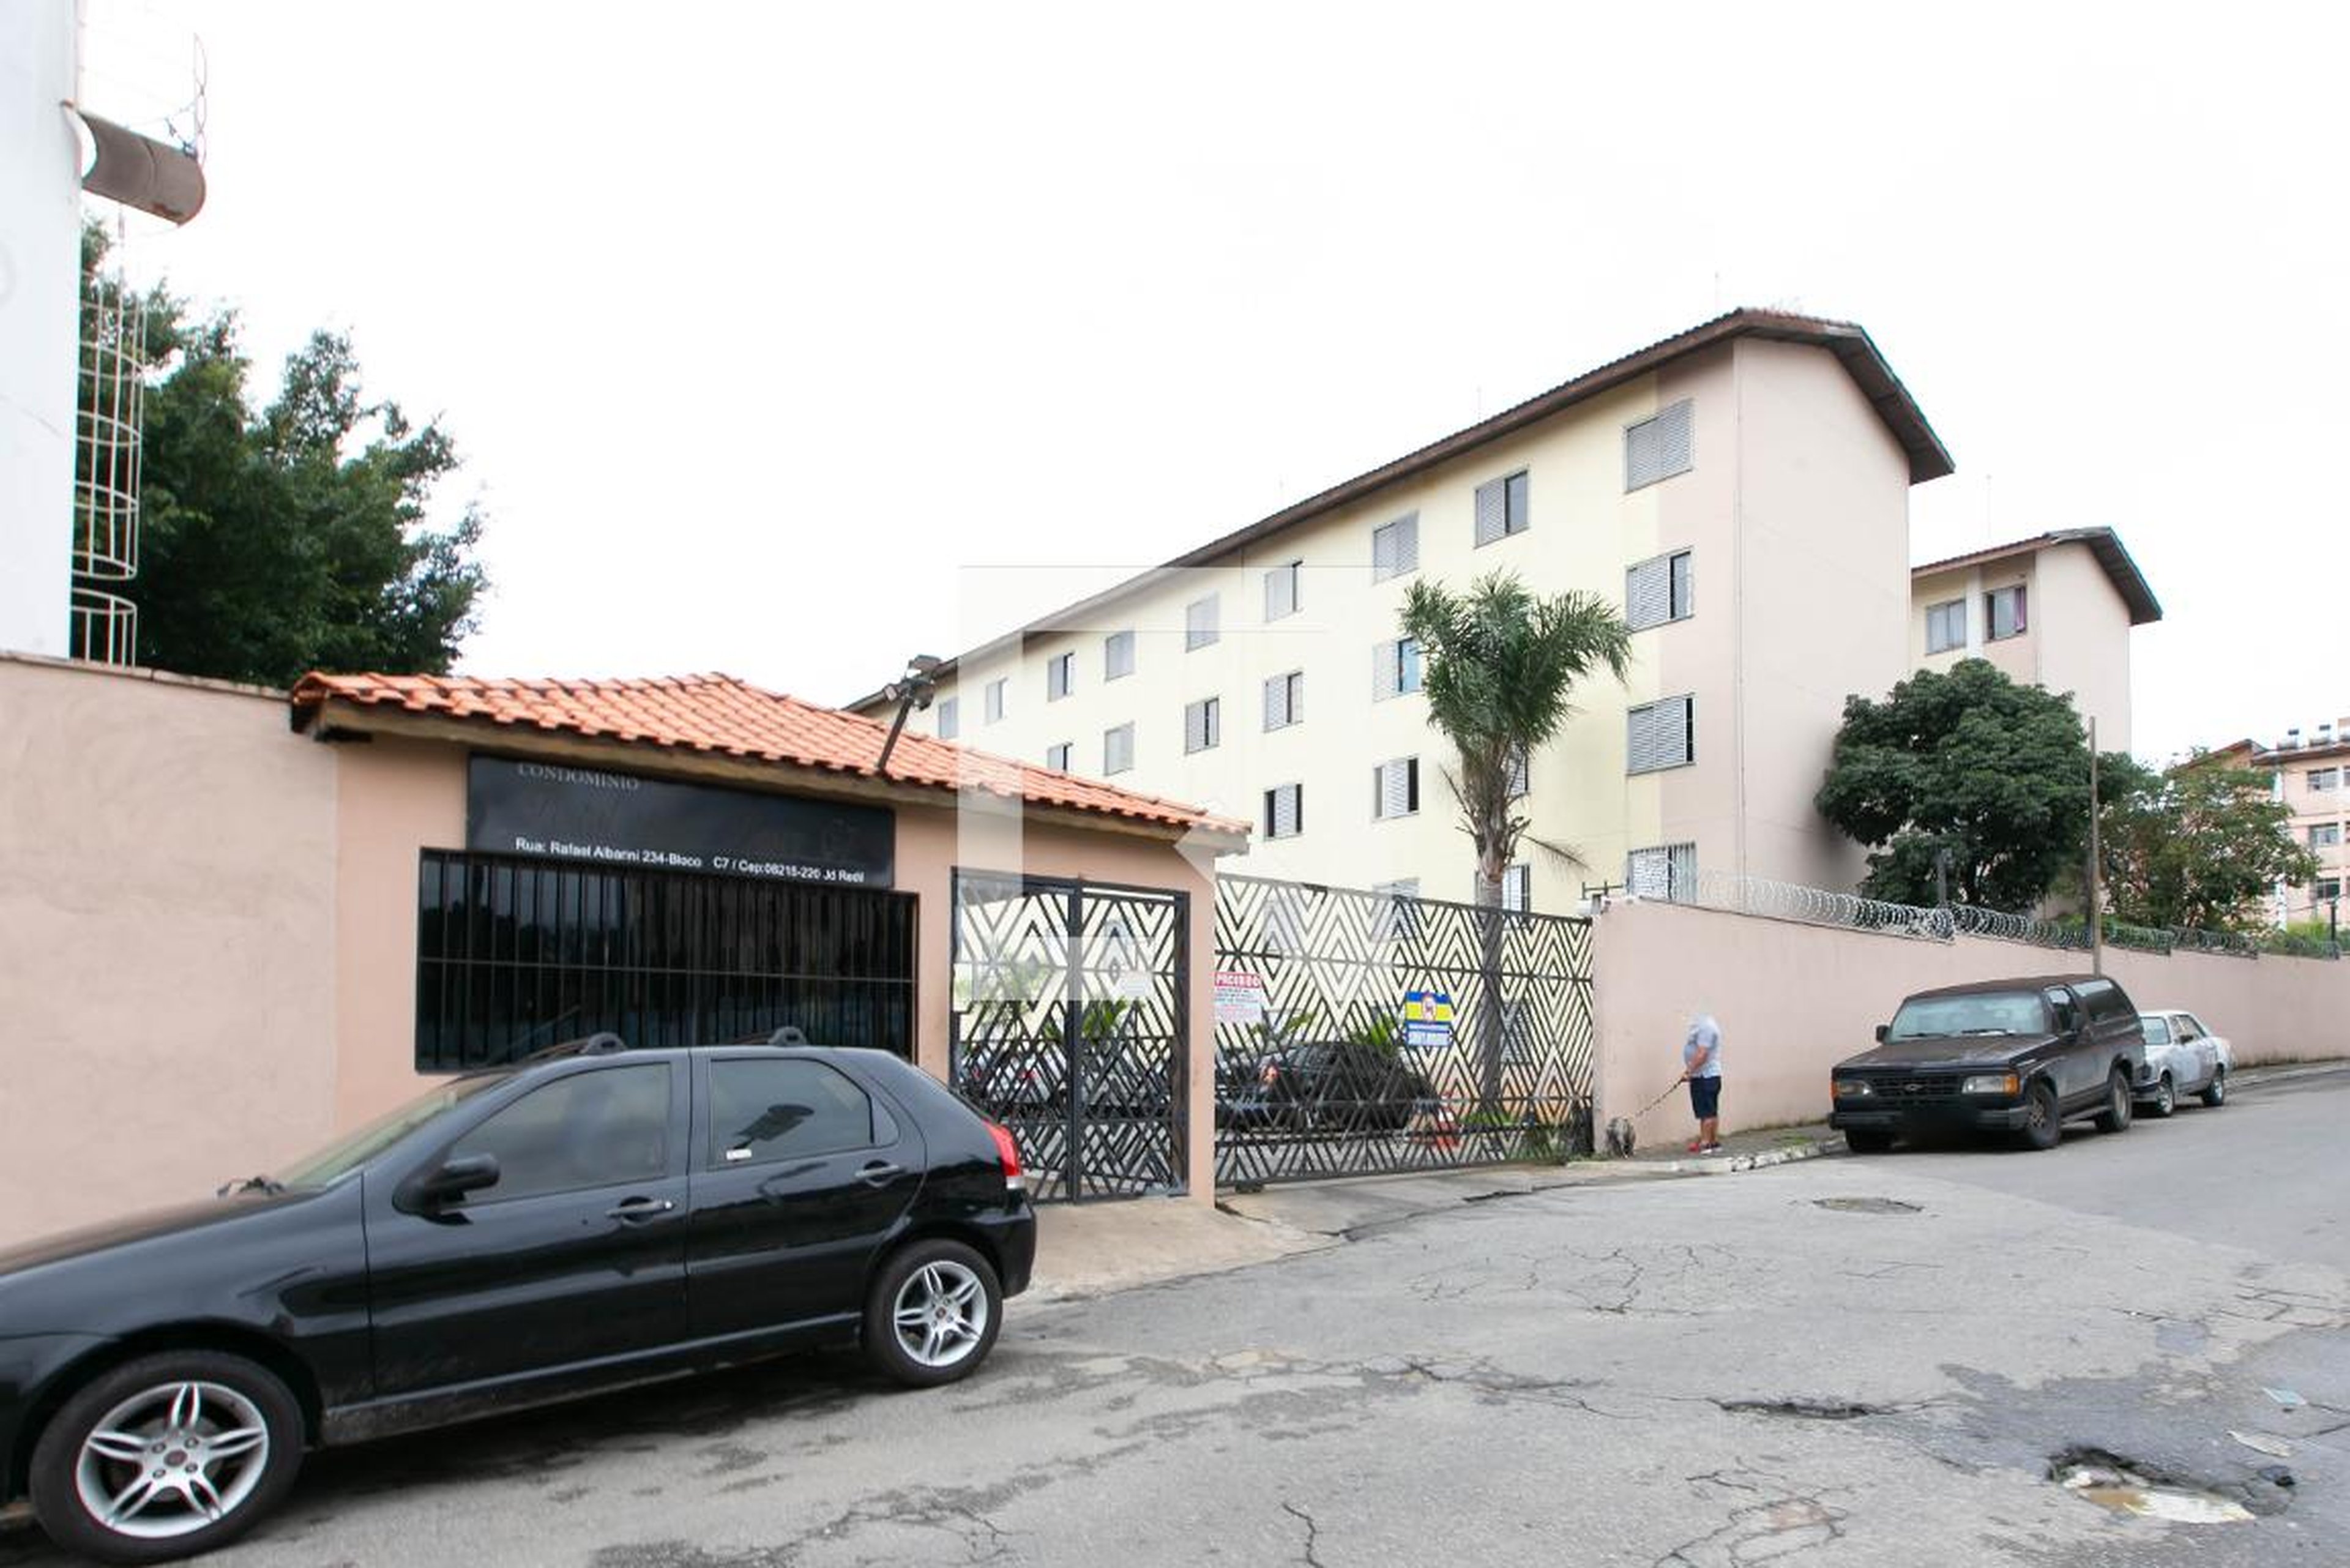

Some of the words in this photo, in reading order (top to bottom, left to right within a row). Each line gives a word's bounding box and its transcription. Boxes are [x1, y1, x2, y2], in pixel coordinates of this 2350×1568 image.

[515, 837, 546, 853] Rua:
[550, 841, 591, 857] Rafael
[714, 857, 729, 870] C7
